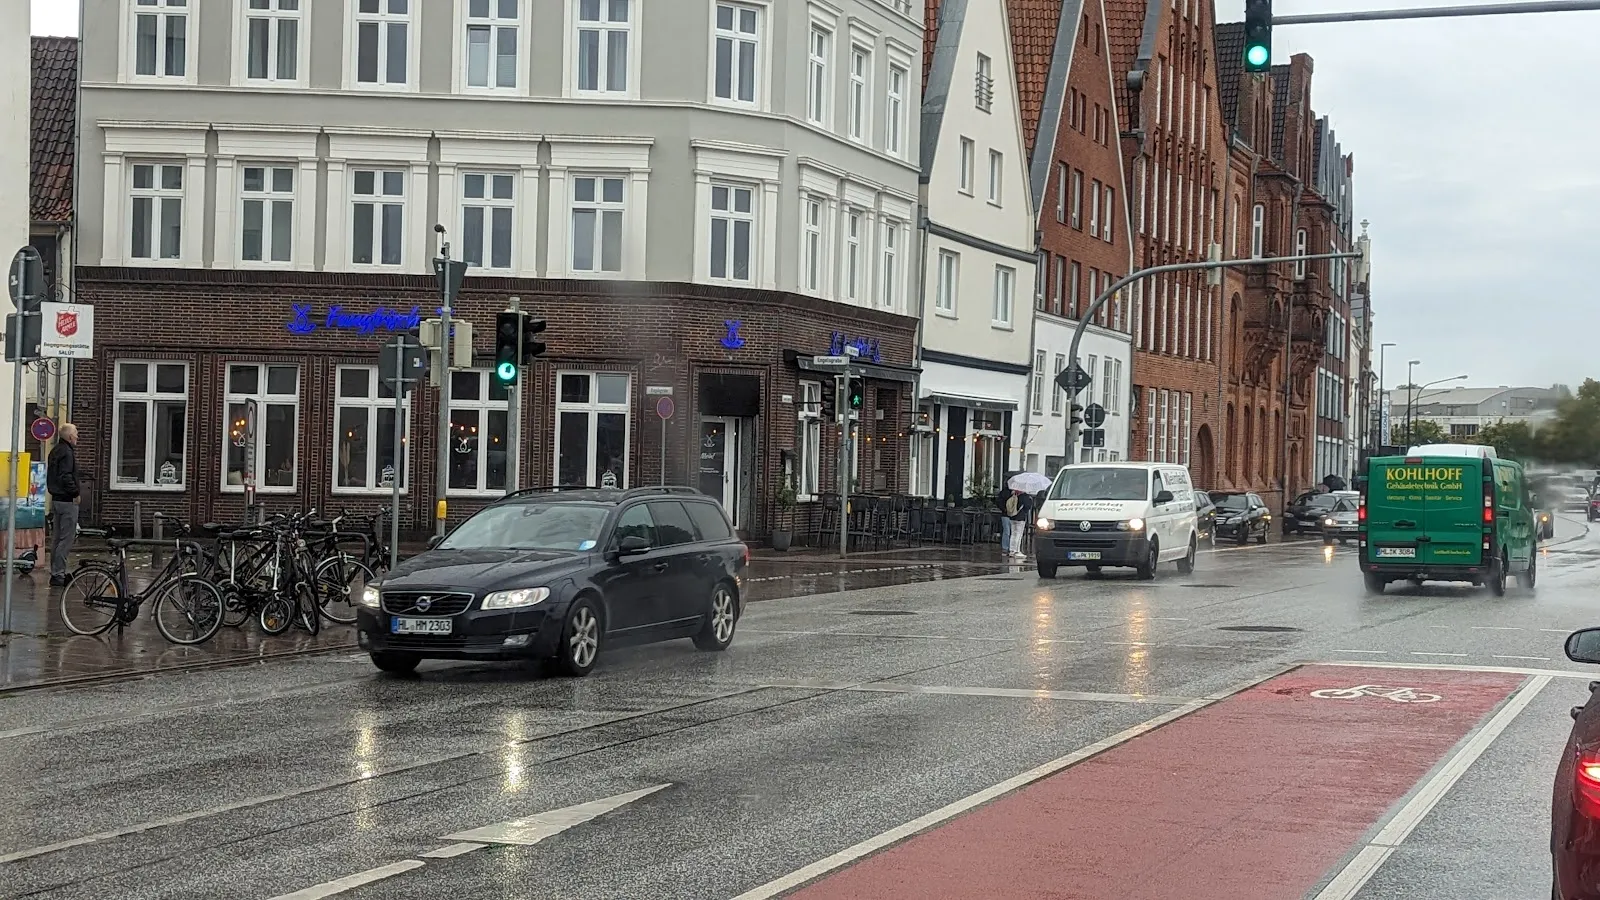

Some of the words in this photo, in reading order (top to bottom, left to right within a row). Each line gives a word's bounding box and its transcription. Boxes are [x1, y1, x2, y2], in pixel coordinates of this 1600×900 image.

[1386, 467, 1463, 481] KOHLHOFF
[1386, 482, 1439, 490] Gebäudetechnik
[1440, 482, 1463, 490] GmbH
[399, 619, 408, 631] HL
[415, 620, 427, 631] HM
[428, 621, 451, 631] 2303
